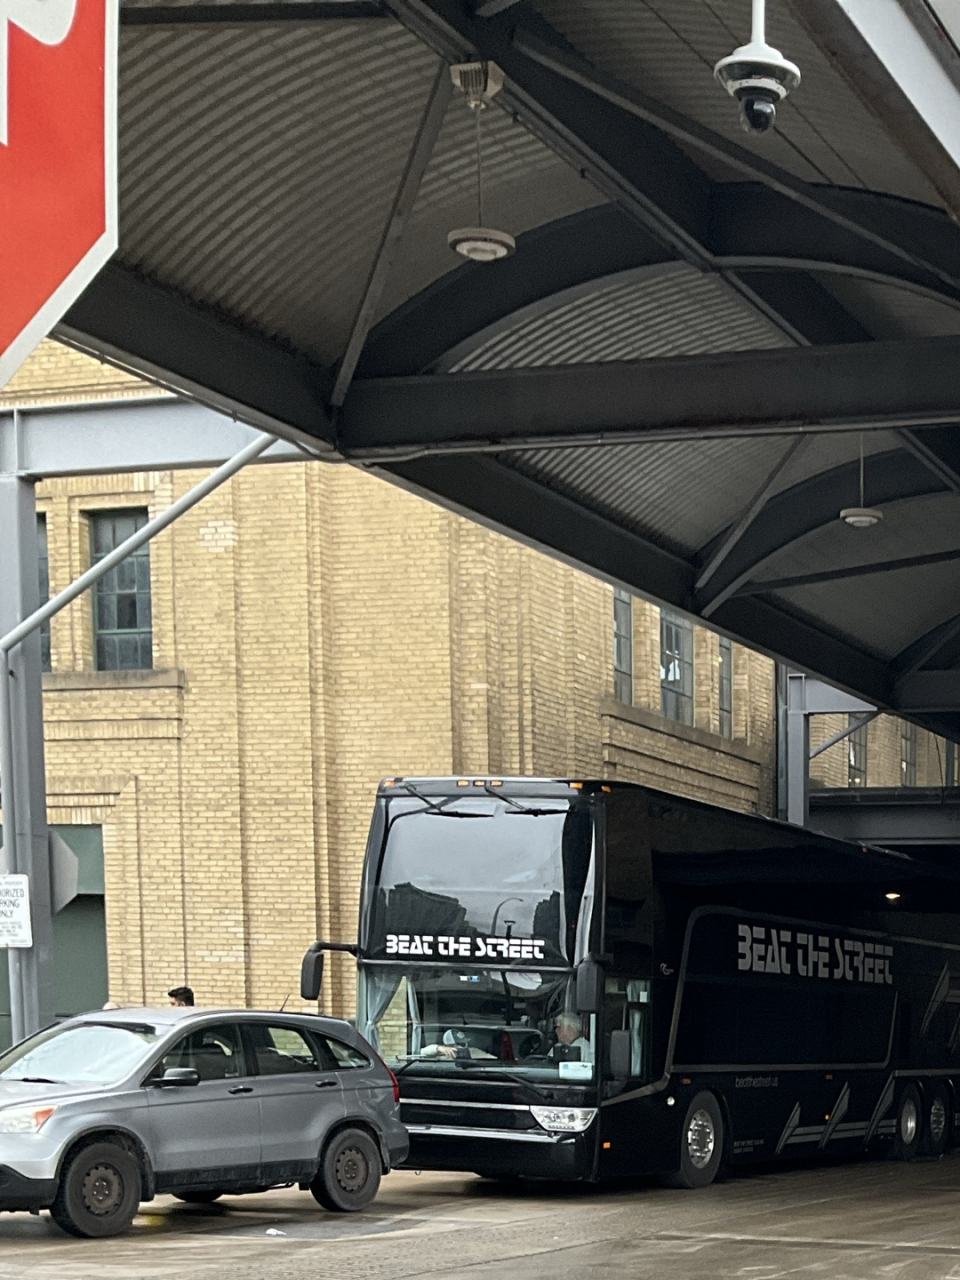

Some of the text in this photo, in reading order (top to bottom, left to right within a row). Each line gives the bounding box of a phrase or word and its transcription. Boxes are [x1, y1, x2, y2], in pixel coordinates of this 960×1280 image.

[386, 934, 545, 959] BEAT THE STREET
[737, 923, 894, 985] BEAT THE STREET
